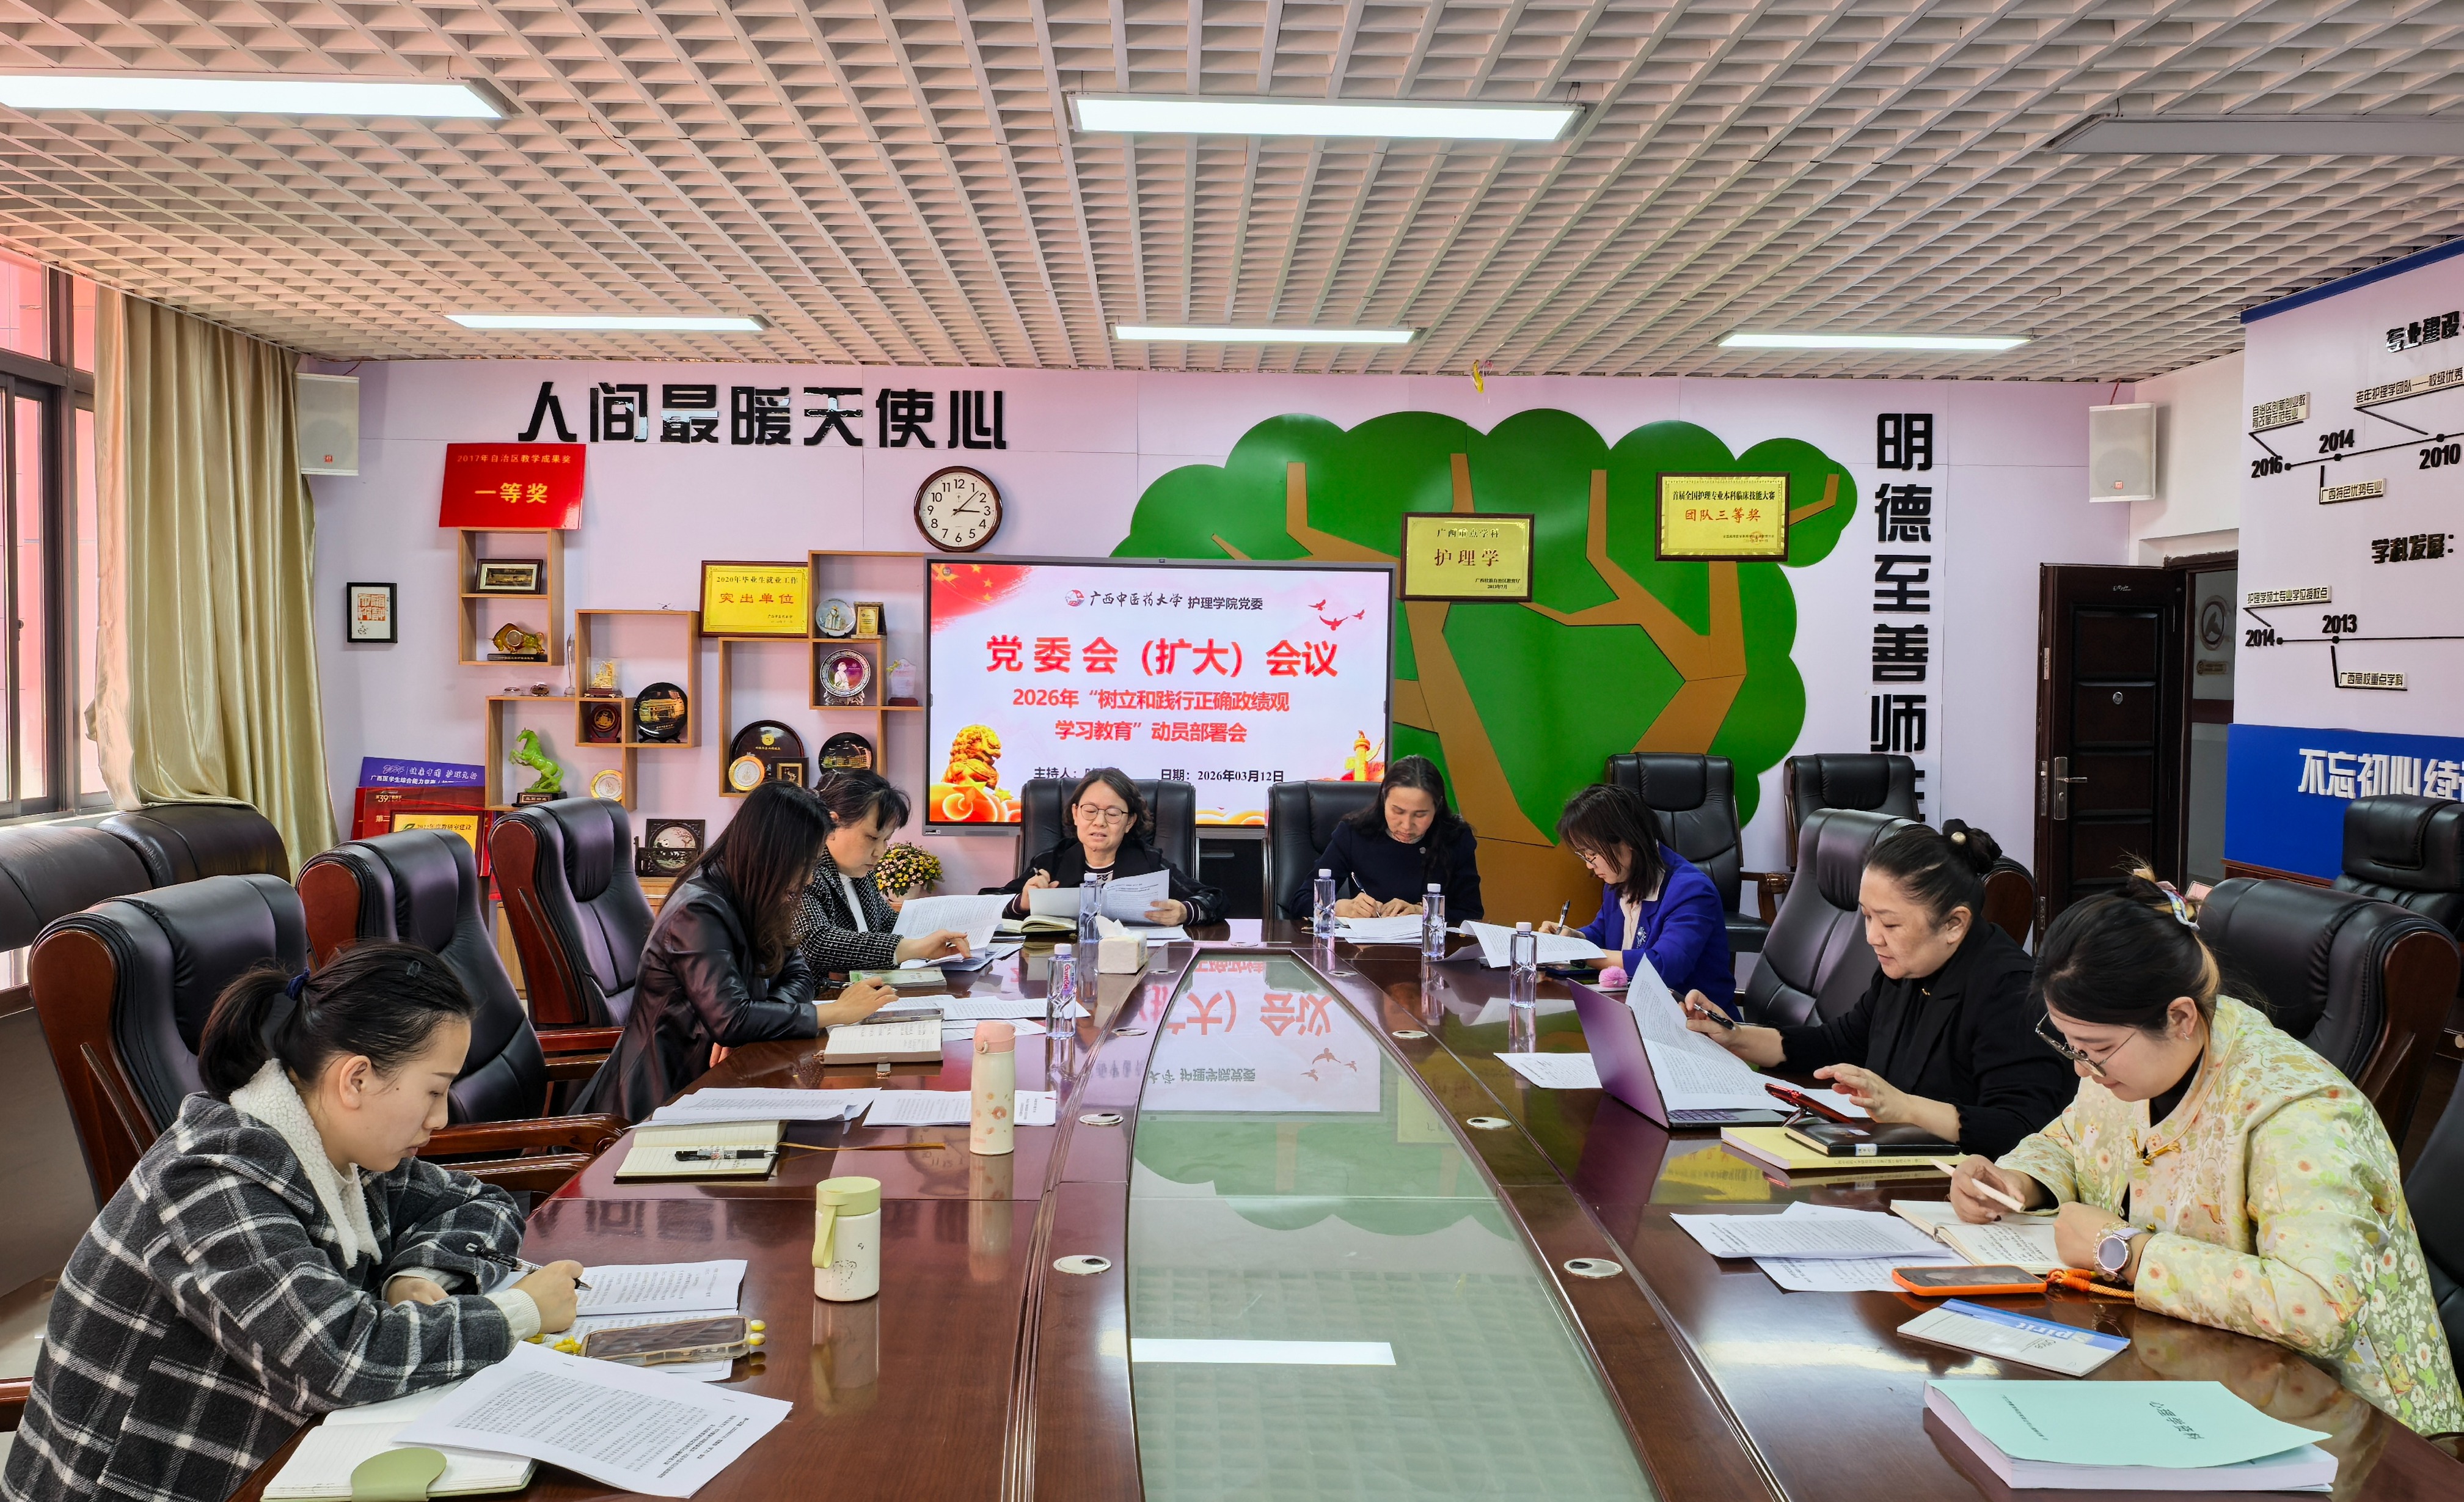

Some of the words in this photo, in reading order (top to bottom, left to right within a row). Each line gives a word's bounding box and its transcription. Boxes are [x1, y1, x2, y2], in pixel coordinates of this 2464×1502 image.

[518, 381, 1007, 450] 人间最暖天使心
[2319, 430, 2355, 453] 2014
[458, 454, 571, 463] 2017年自治区教学成果奖
[2419, 443, 2461, 469] 2010
[2251, 456, 2283, 478] 2016
[942, 483, 950, 492] 11
[954, 479, 965, 489] 12
[971, 483, 974, 493] 1
[475, 483, 548, 504] 一等奖
[931, 492, 942, 502] 10
[979, 493, 986, 502] 2
[1673, 491, 1775, 500] 首届全国护理专业本科临床技能大赛
[927, 505, 934, 515] 9
[984, 506, 990, 516] 3
[1685, 507, 1761, 523] 团队三等奖
[931, 518, 938, 528] 8
[979, 519, 986, 529] 4
[942, 529, 948, 538] 7
[955, 533, 962, 542] 6
[969, 529, 976, 538] 5
[1435, 548, 1499, 566] 护理学
[717, 576, 798, 584] 2020年毕业生就业工作
[718, 592, 794, 604] 突出单位
[1090, 590, 1183, 607] 广西中医药大学
[1188, 596, 1263, 610] 护理学院党委
[1870, 413, 1932, 822] 明德至善师
[2322, 614, 2357, 633] 2013
[2245, 629, 2275, 647] 2014
[1012, 688, 1290, 713] 2026年“树立和践行正确政绩观
[1055, 719, 1248, 744] 学习教育”动员部署会
[2298, 748, 2464, 802] 不忘初心续
